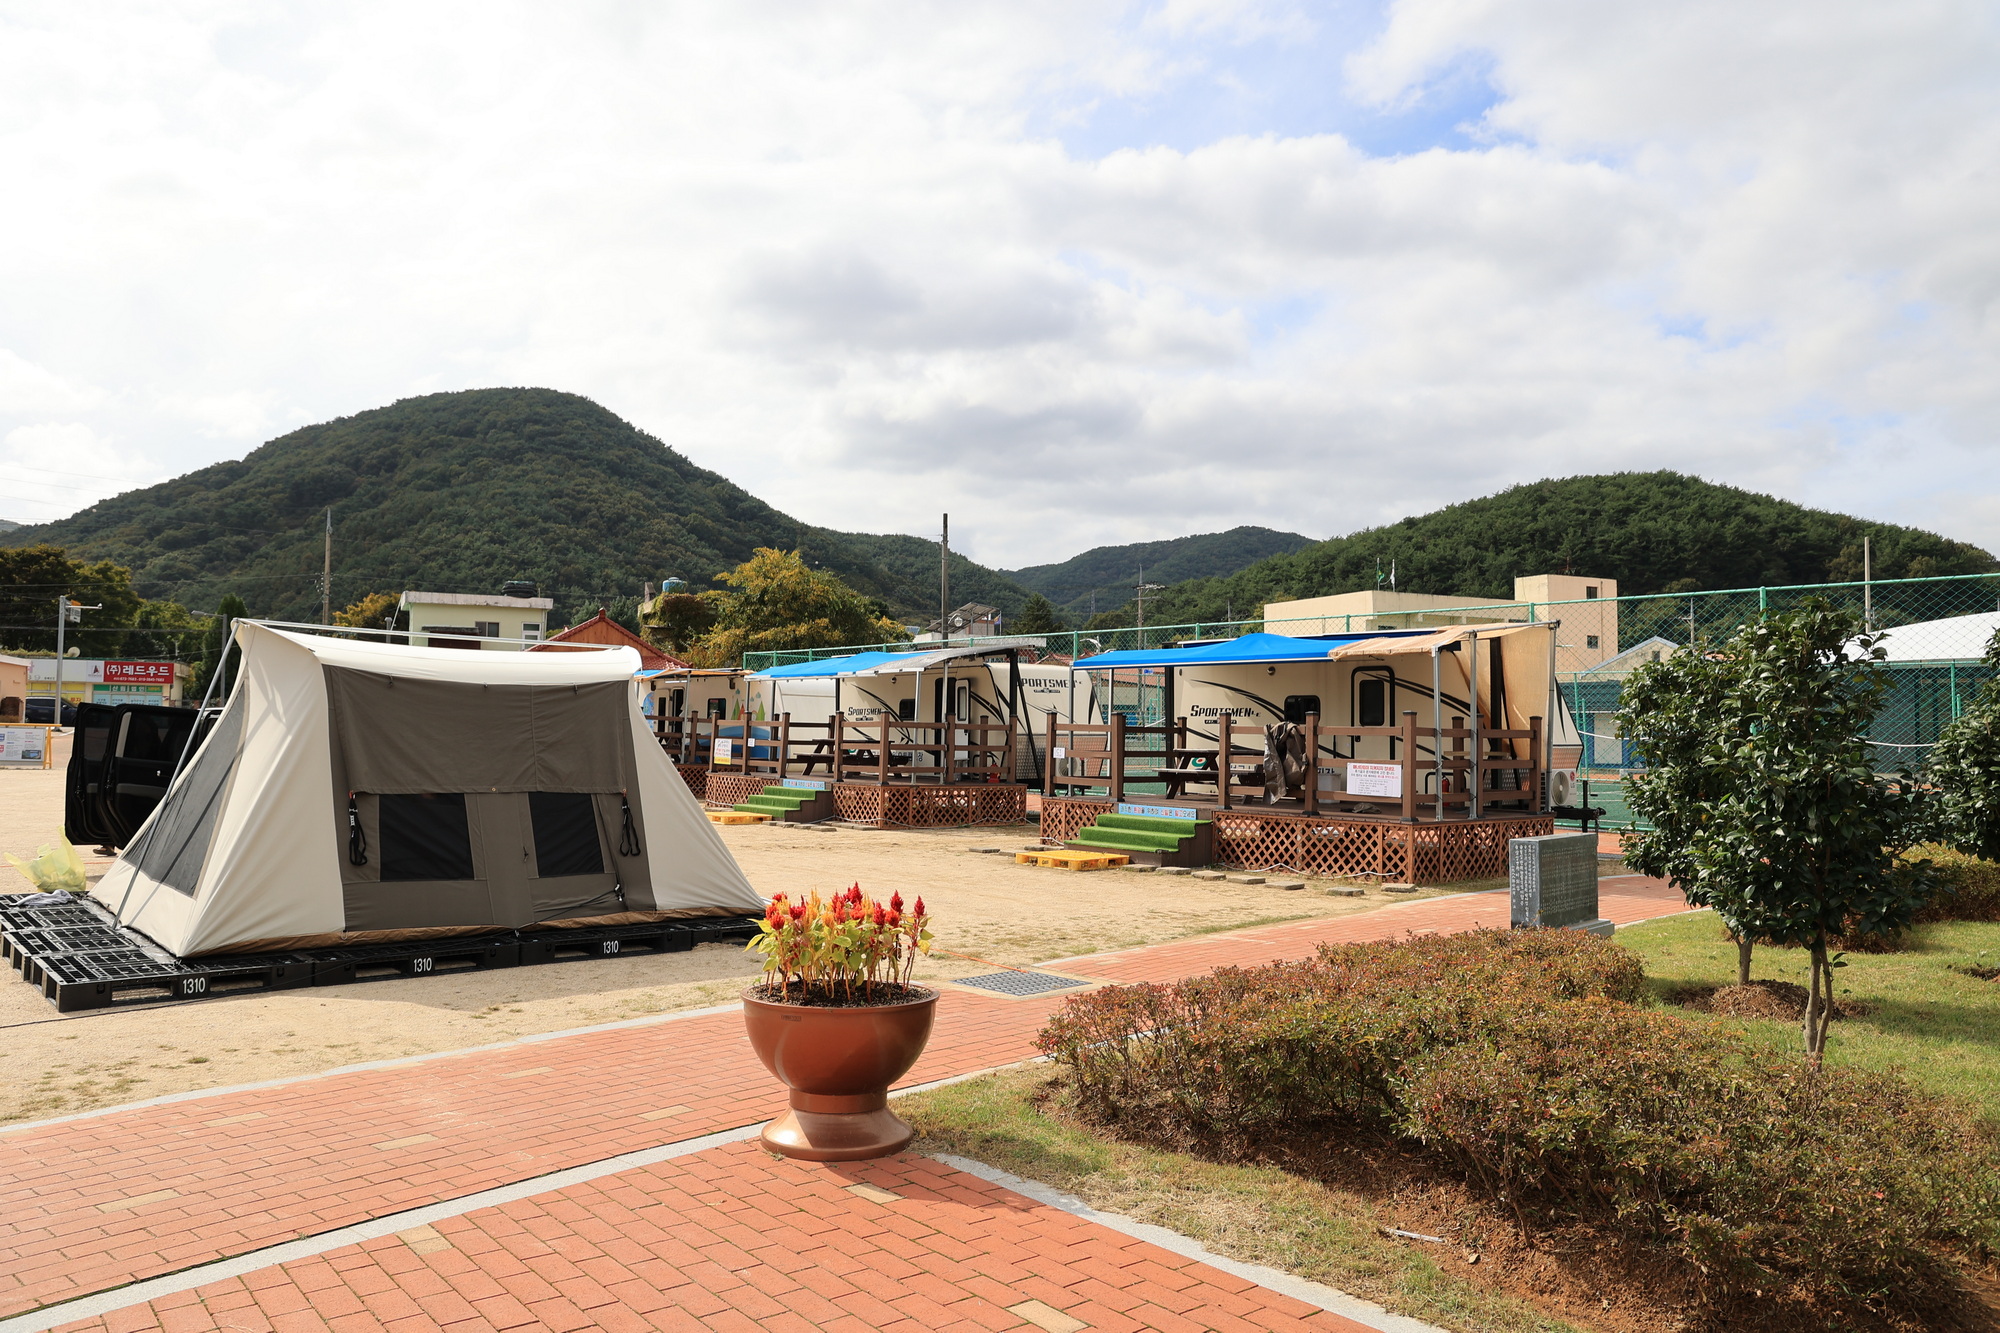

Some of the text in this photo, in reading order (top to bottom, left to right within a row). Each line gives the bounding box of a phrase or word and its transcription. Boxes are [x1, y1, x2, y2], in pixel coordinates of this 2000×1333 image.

[602, 940, 619, 954] 1310
[413, 957, 432, 973] 1310
[182, 977, 205, 993] 1310
